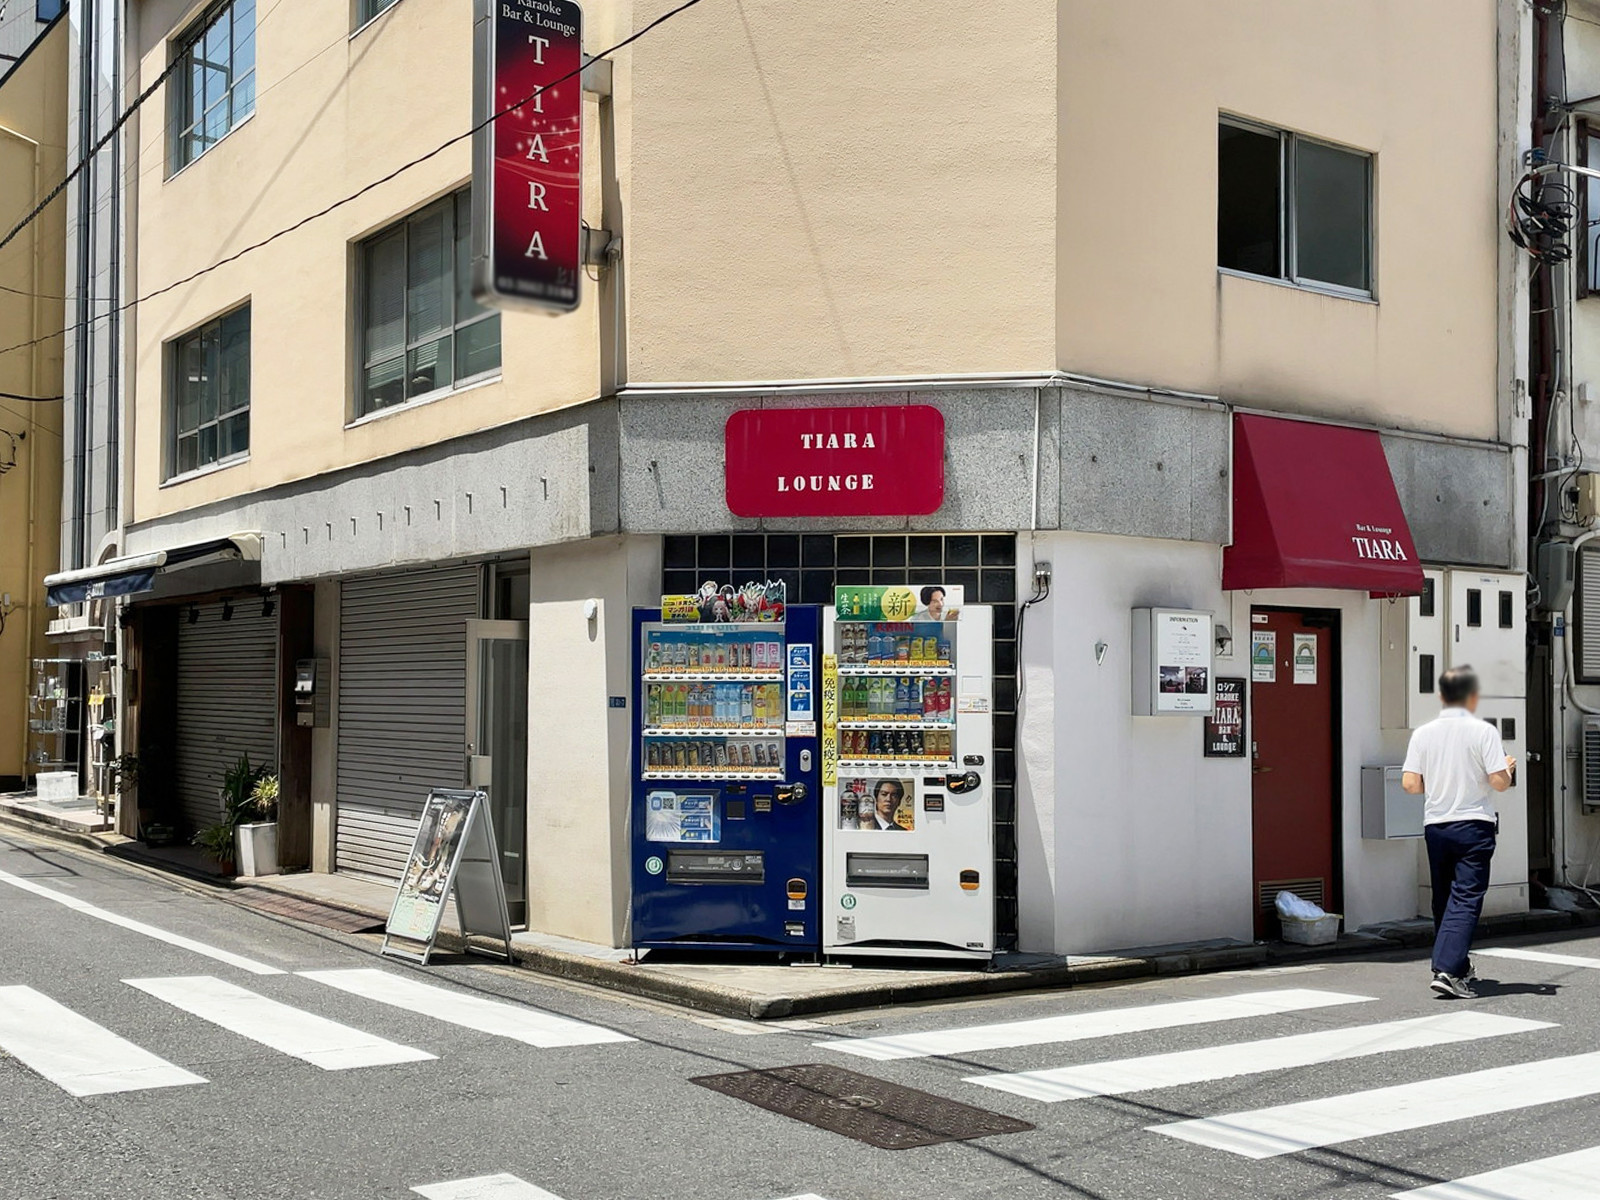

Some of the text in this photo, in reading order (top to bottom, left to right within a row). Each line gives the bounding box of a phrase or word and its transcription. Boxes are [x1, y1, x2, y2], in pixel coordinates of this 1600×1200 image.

[502, 4, 576, 37] Bar & Lounge
[525, 35, 549, 260] TIARA
[801, 433, 875, 449] TIARA
[778, 475, 874, 492] LOUNGE
[1352, 537, 1408, 560] TIARA
[888, 592, 911, 616] 新
